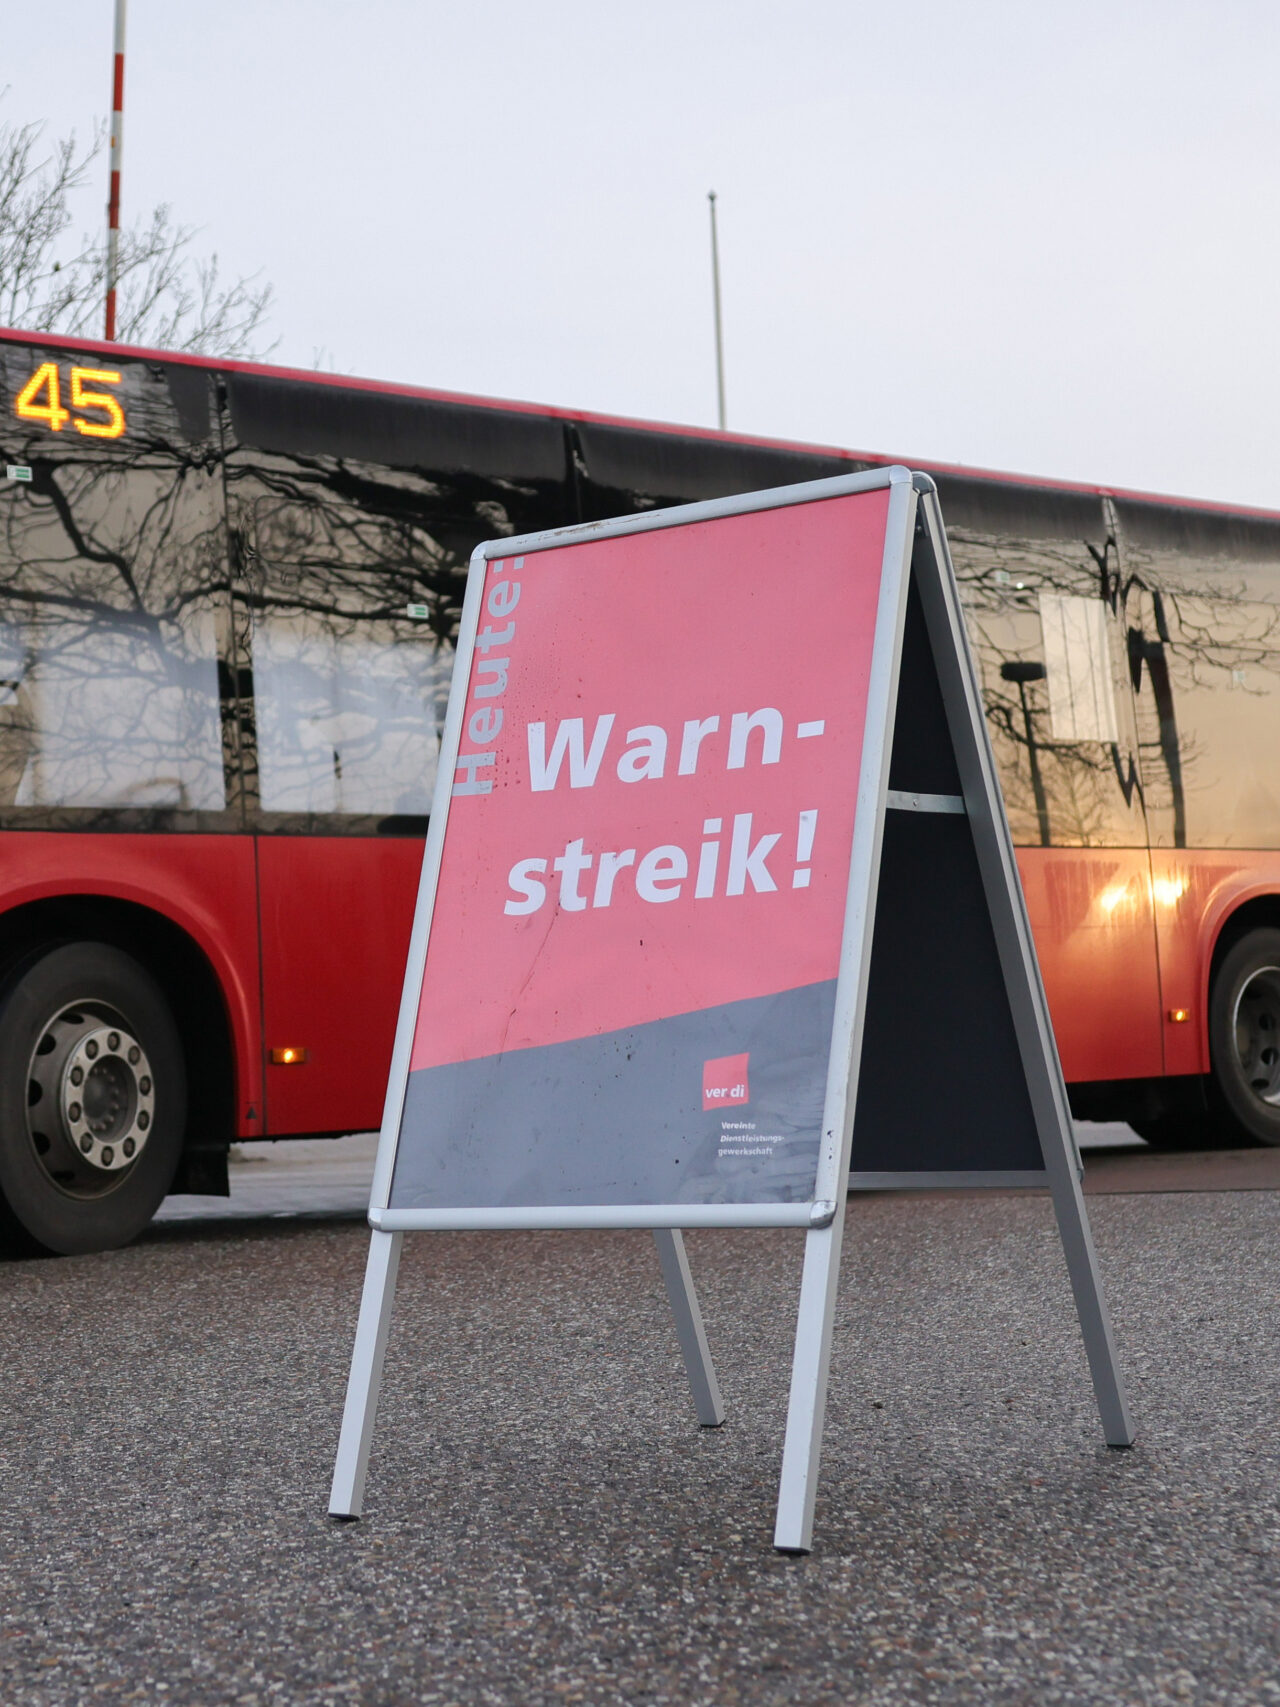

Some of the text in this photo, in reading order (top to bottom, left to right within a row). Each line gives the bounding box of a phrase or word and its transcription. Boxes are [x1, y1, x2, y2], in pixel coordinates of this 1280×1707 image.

[17, 362, 124, 438] 45
[452, 556, 525, 796] Heute:
[527, 707, 826, 792] Warn-
[503, 809, 818, 915] streik!
[718, 1146, 773, 1157] gewerkschaft
[720, 1134, 785, 1144] Dienstleistungs-
[721, 1121, 756, 1130] Vereinte
